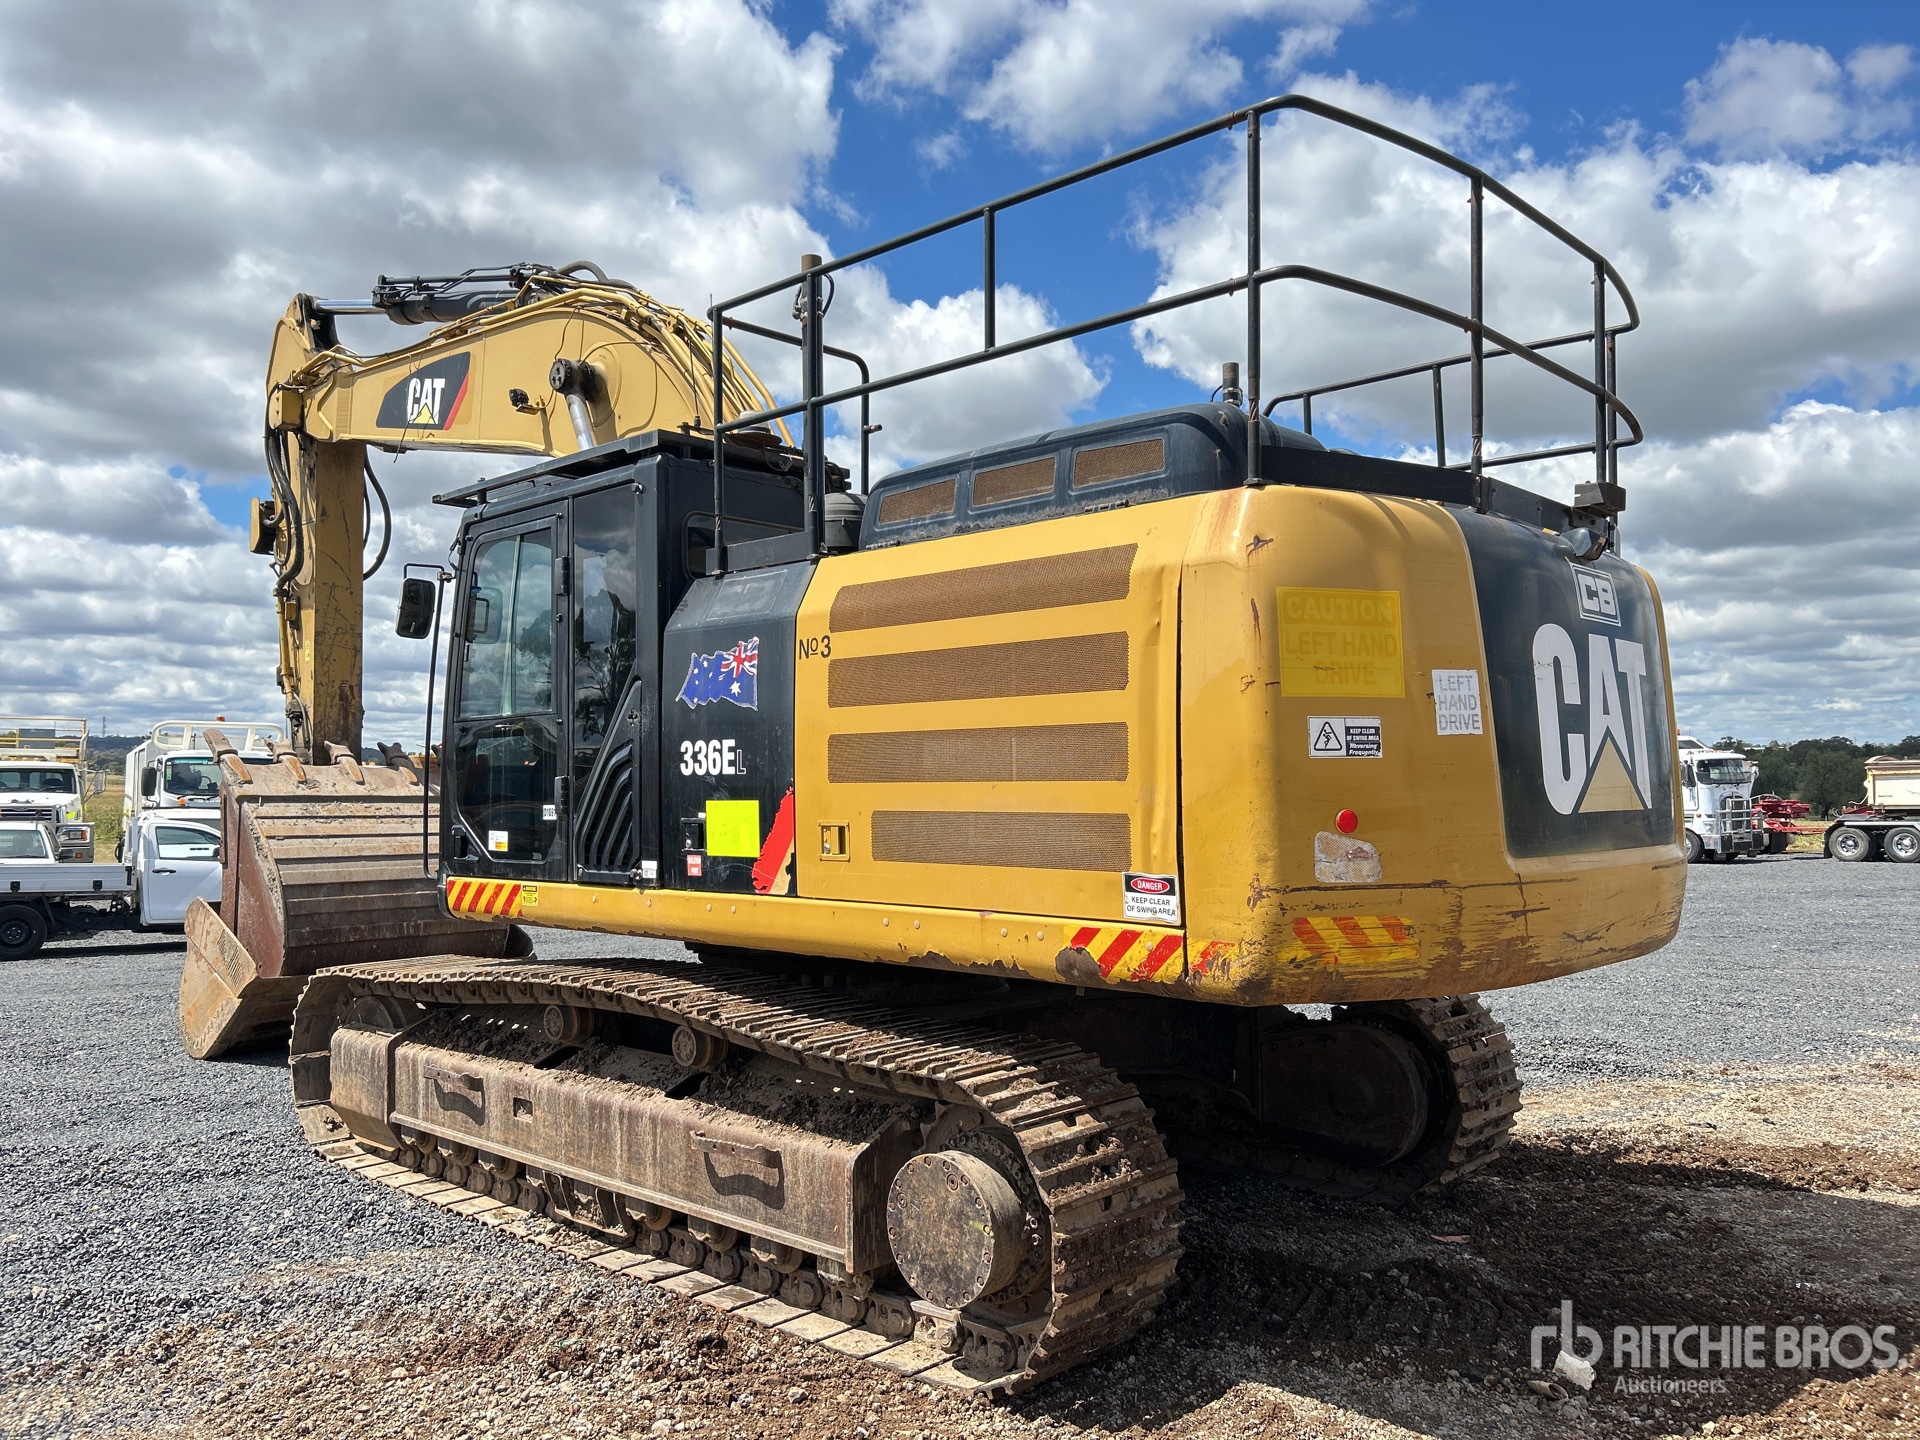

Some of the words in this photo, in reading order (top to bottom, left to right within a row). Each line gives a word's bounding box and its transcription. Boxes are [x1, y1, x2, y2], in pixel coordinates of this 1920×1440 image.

[407, 377, 446, 425] CAT
[1577, 573, 1617, 616] CB
[1286, 596, 1393, 623] CAUTION
[1284, 631, 1336, 656] LEFT
[1343, 633, 1397, 658] HAND
[1314, 660, 1376, 686] DRIVE
[1438, 674, 1473, 692] LEFT
[1438, 694, 1478, 712] HAND
[1438, 713, 1481, 731] DRIVE
[1532, 623, 1652, 815] CAT
[1137, 880, 1163, 891] DANGER
[1126, 904, 1136, 912] OF
[1136, 905, 1157, 914] SWING
[1158, 908, 1176, 916] AREA
[1131, 896, 1148, 904] KEEP
[1149, 897, 1171, 906] CLEAR
